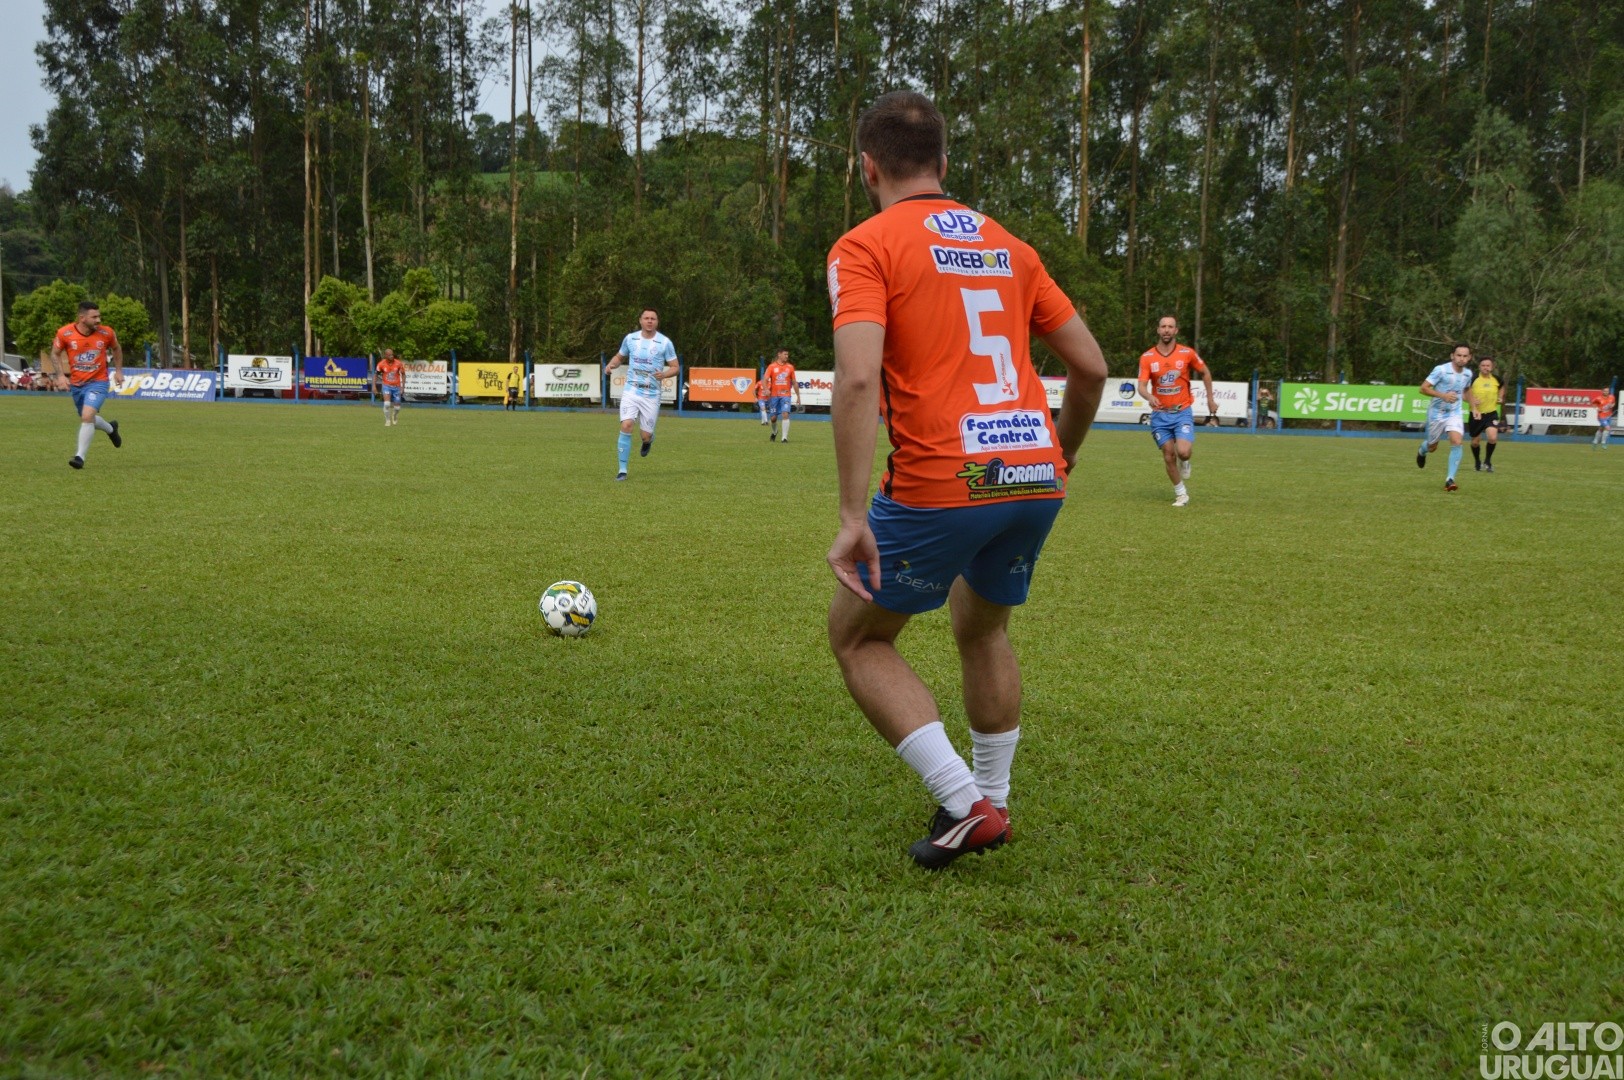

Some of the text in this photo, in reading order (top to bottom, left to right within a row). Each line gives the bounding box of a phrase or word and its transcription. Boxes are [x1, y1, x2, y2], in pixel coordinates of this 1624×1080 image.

[933, 247, 1010, 269] DREBOR
[961, 287, 1019, 405] 5
[141, 390, 175, 398] nutrição
[545, 382, 590, 392] TURISMO
[1324, 392, 1405, 413] Sicredi
[1542, 394, 1591, 405] VALTRA
[1541, 408, 1588, 418] VOLKWEIS
[966, 414, 1042, 431] Farmácia
[977, 429, 1038, 445] Central
